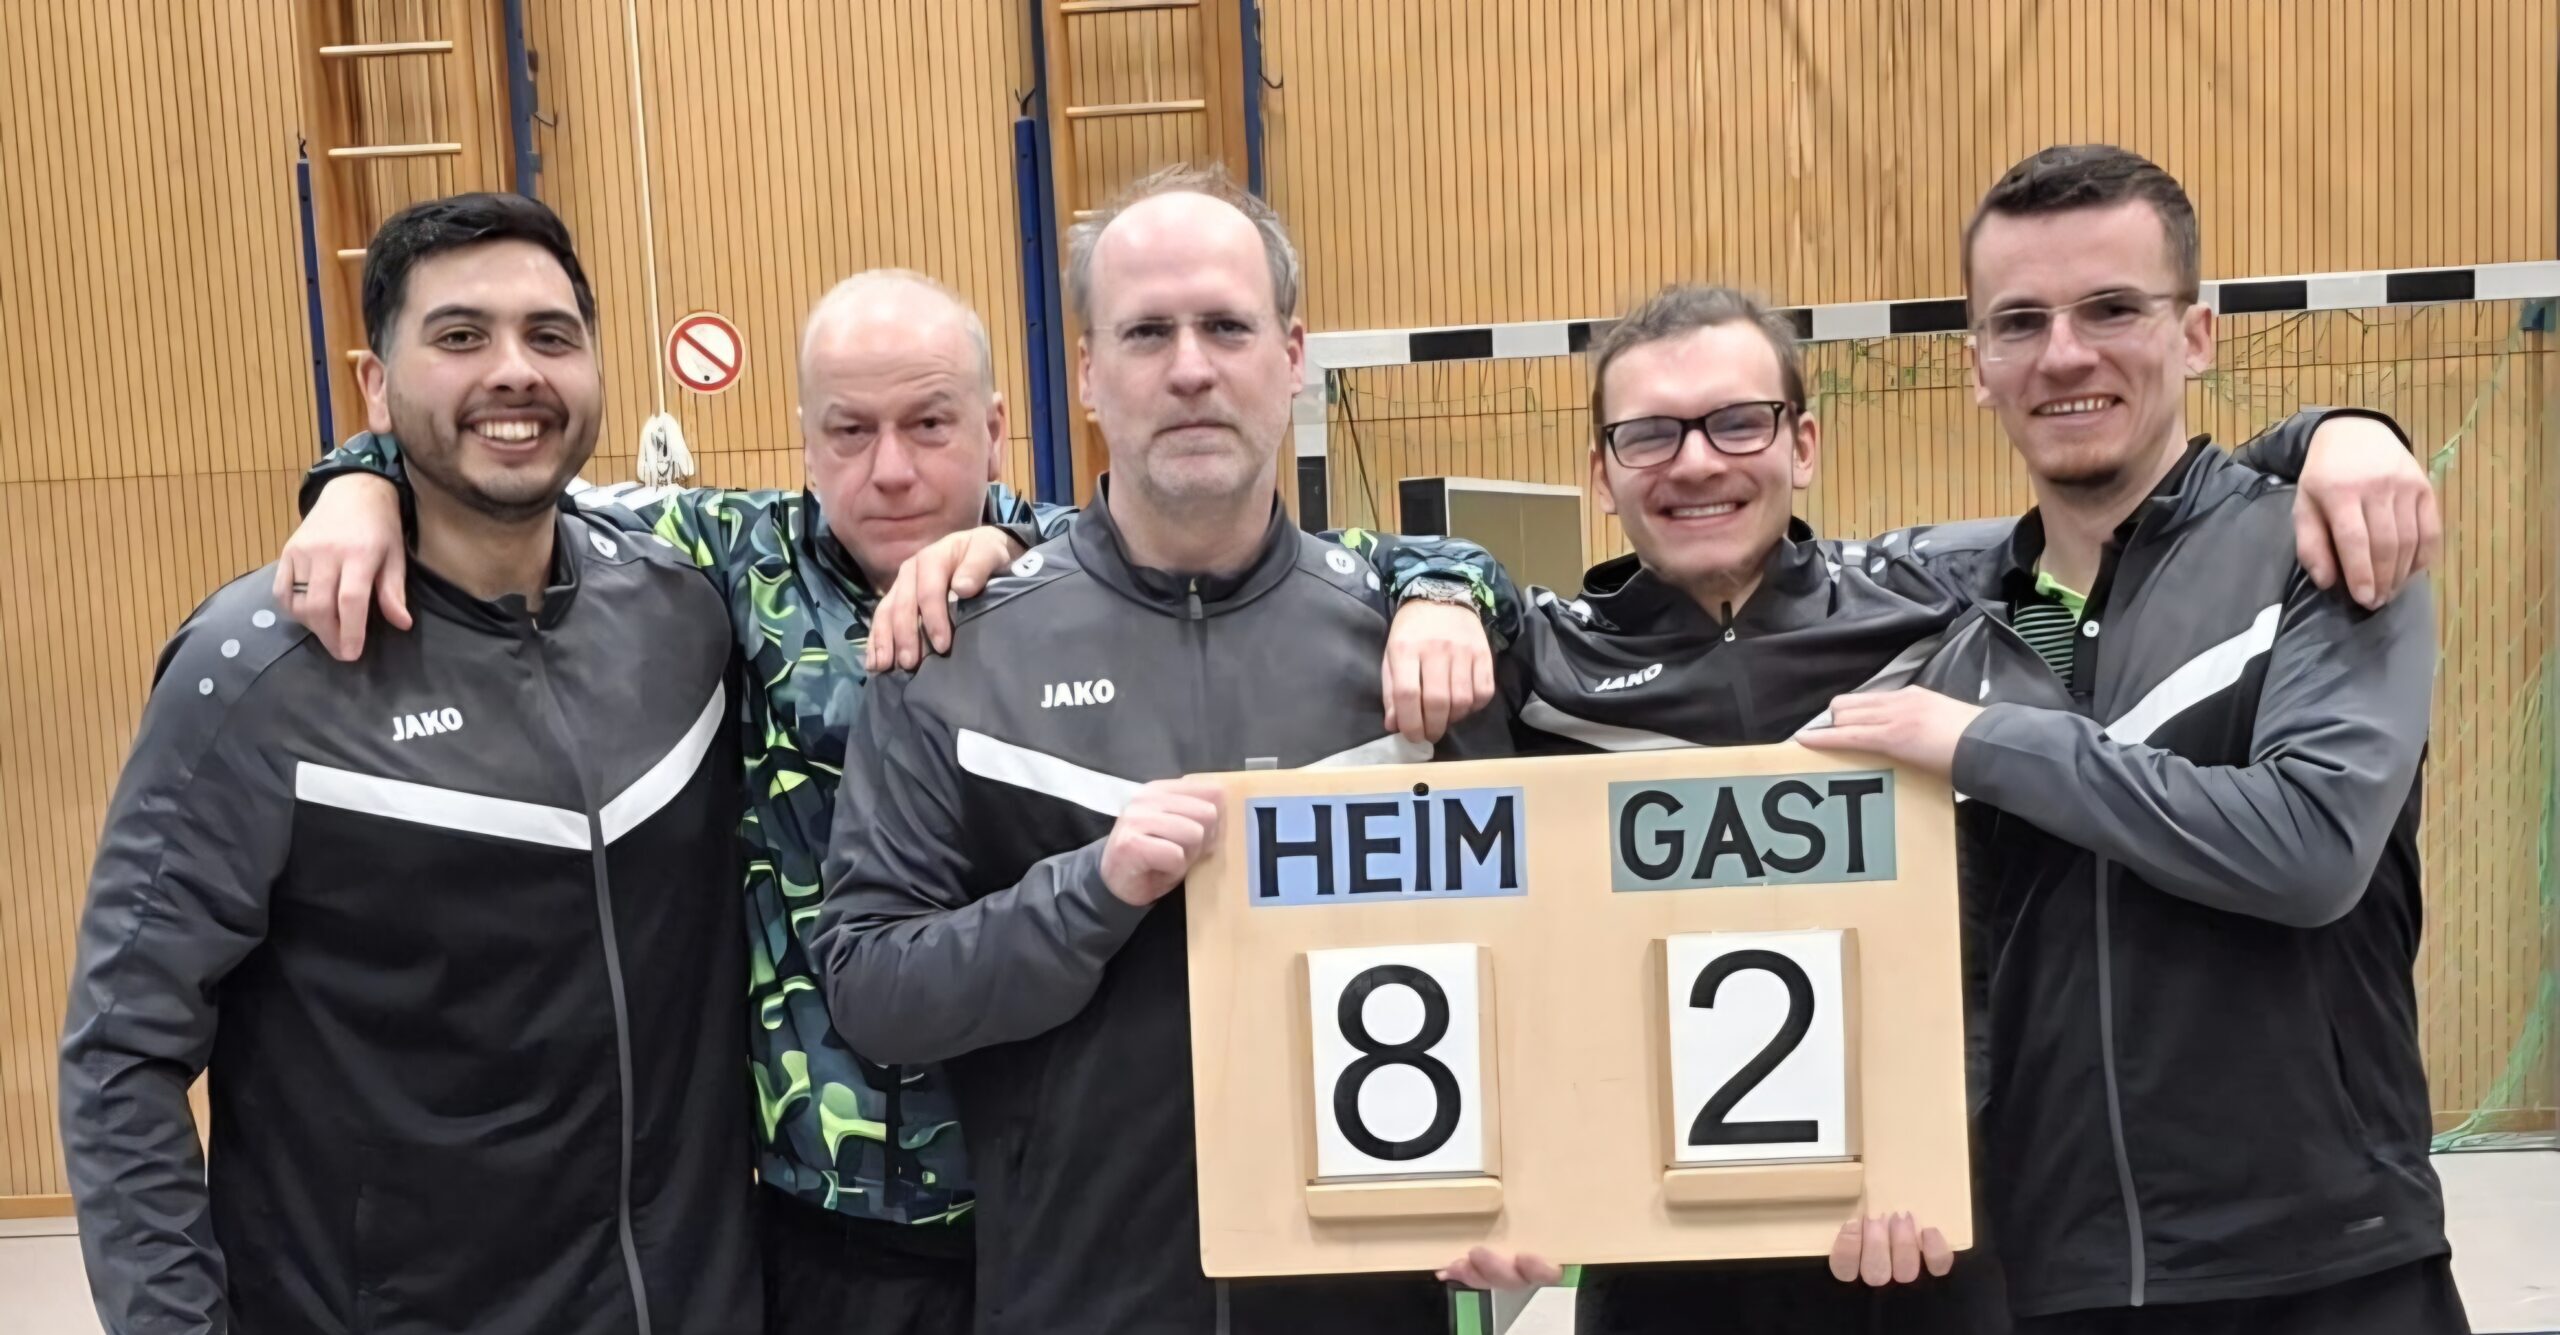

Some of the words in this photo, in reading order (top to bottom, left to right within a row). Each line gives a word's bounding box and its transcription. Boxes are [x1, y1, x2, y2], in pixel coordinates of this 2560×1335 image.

[392, 707, 464, 741] JAKO
[1040, 678, 1115, 708] JAKO
[1618, 777, 1885, 882] GAST
[1332, 963, 1462, 1162] 8
[1687, 949, 1819, 1147] 2
